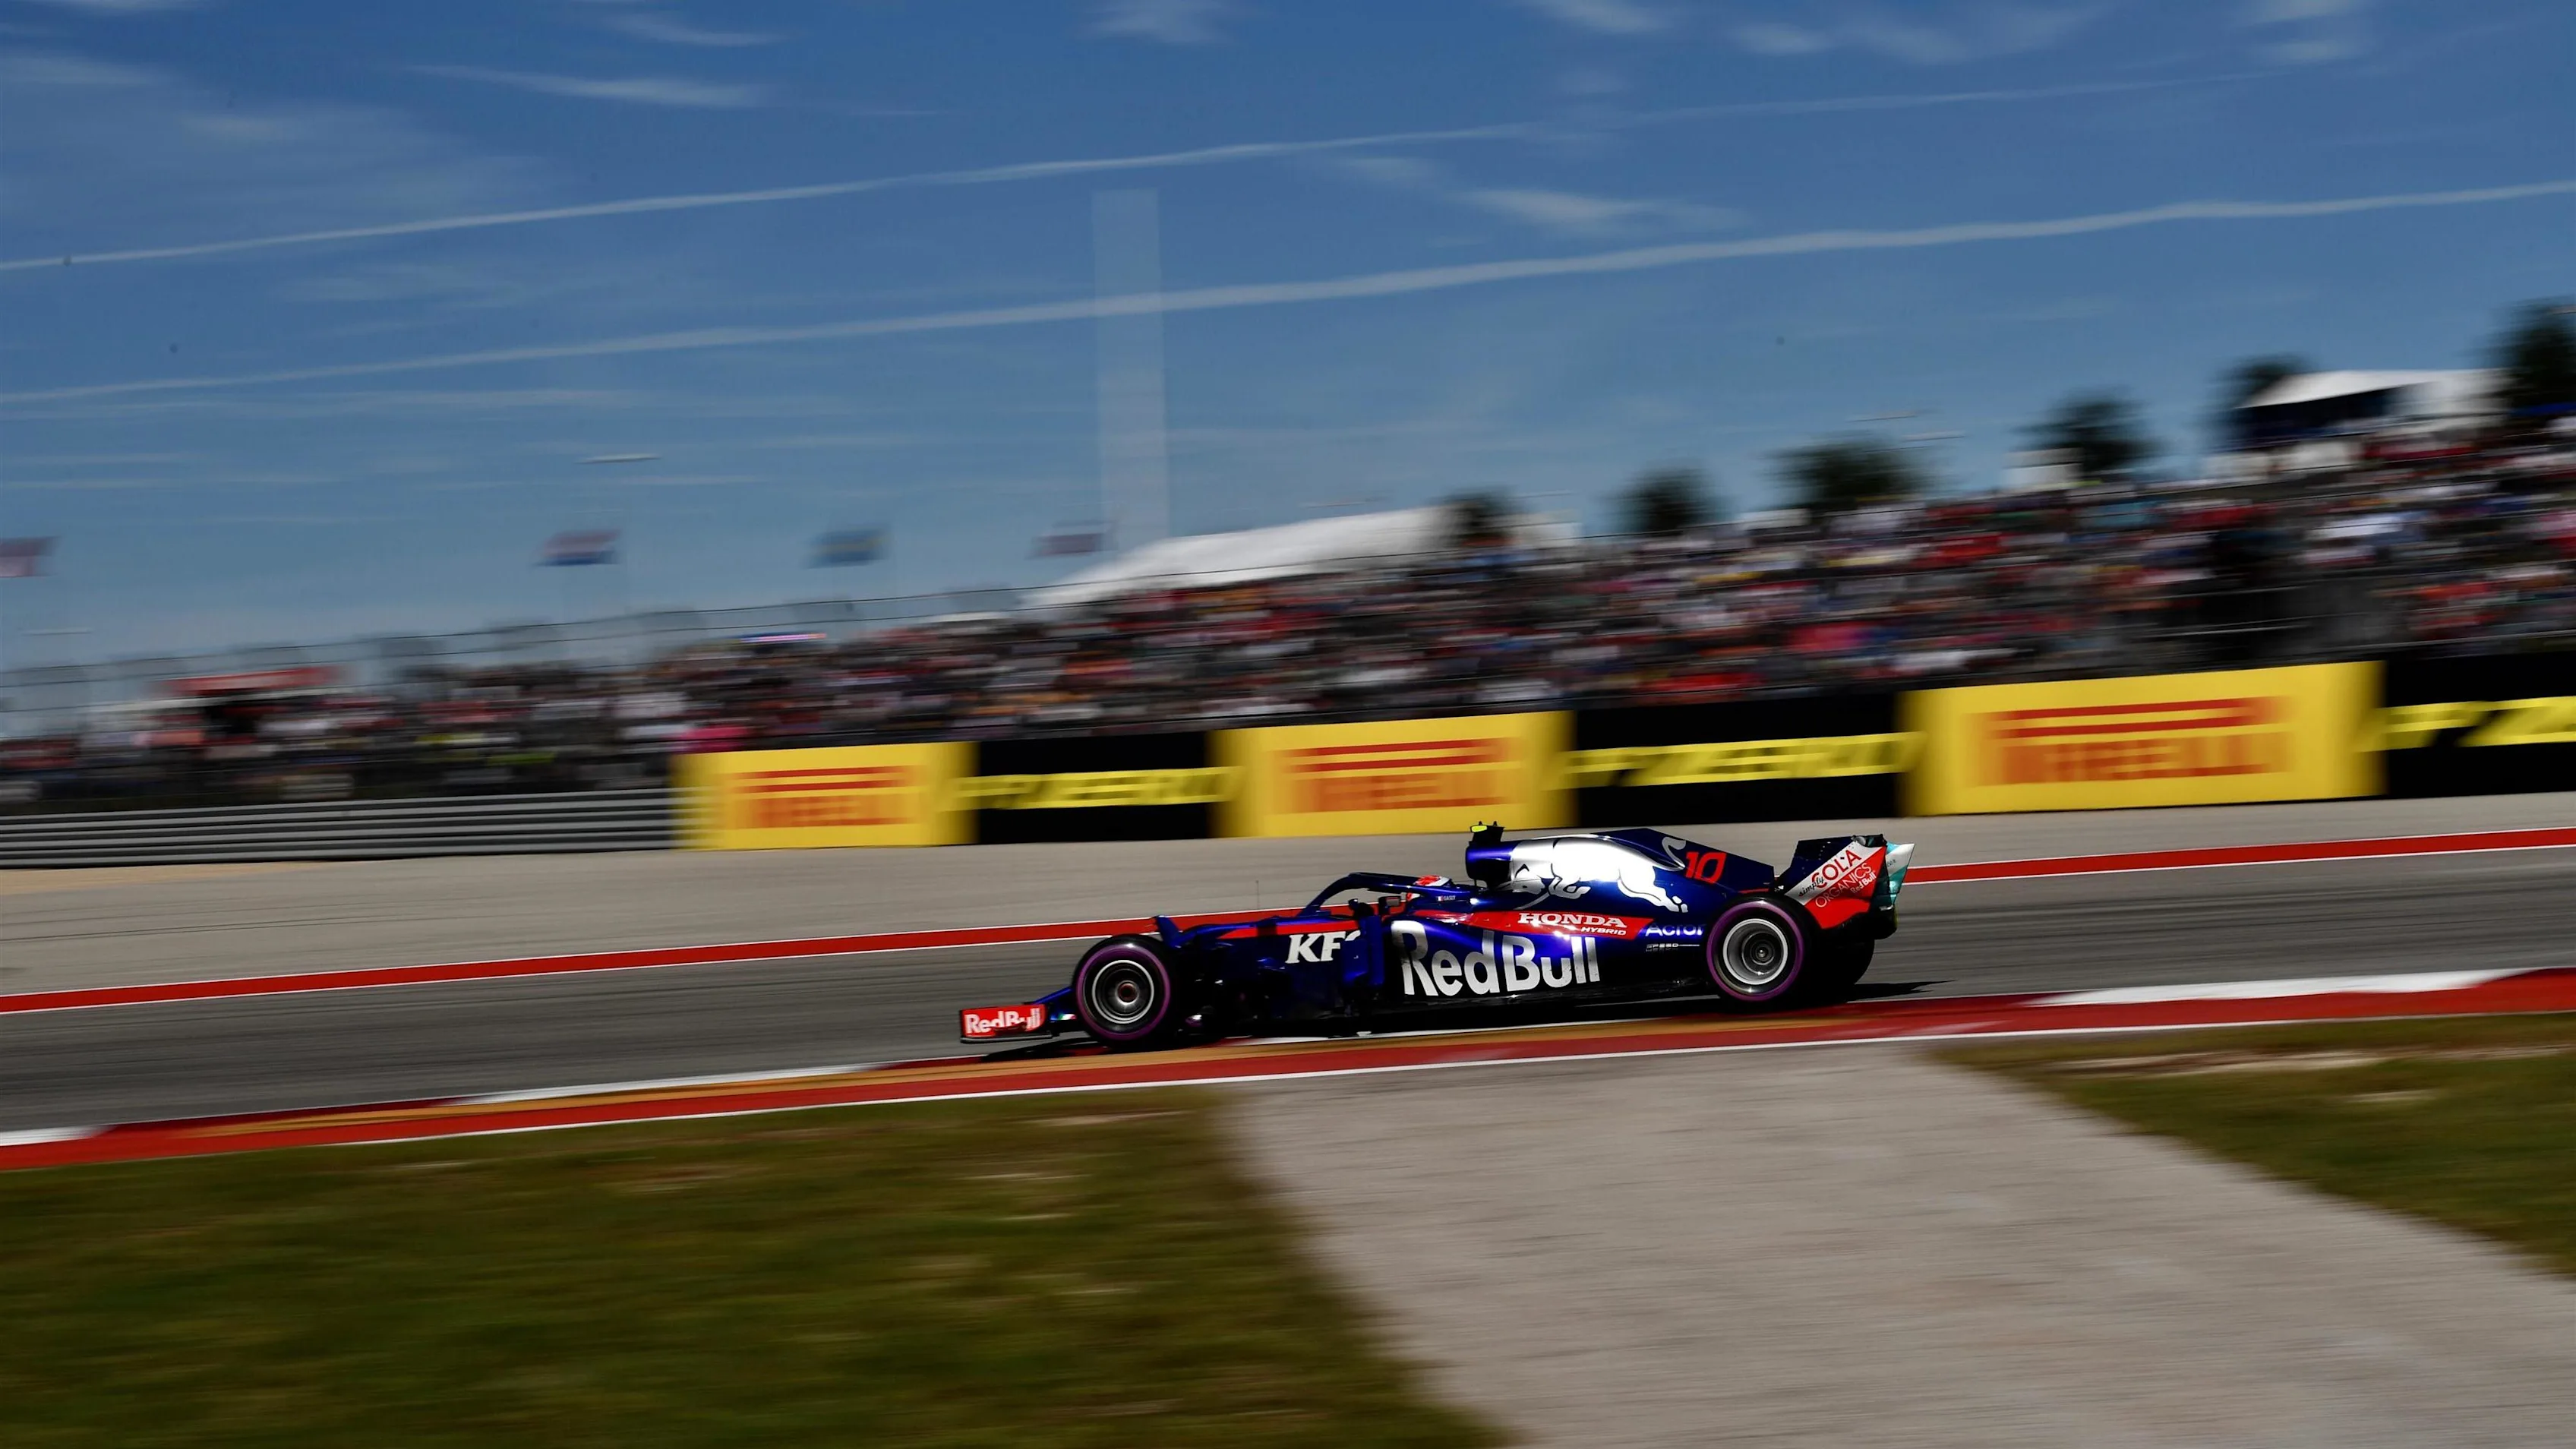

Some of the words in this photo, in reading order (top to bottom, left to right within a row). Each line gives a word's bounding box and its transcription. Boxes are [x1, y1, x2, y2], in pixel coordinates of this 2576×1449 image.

[1685, 851, 1727, 884] 10
[1811, 850, 1862, 889] COLA
[1798, 876, 1825, 897] simply
[1815, 862, 1872, 908] ORGANICS
[1517, 913, 1627, 928] HONDA
[1580, 926, 1627, 936] HYBRID
[1285, 930, 1361, 964] KF
